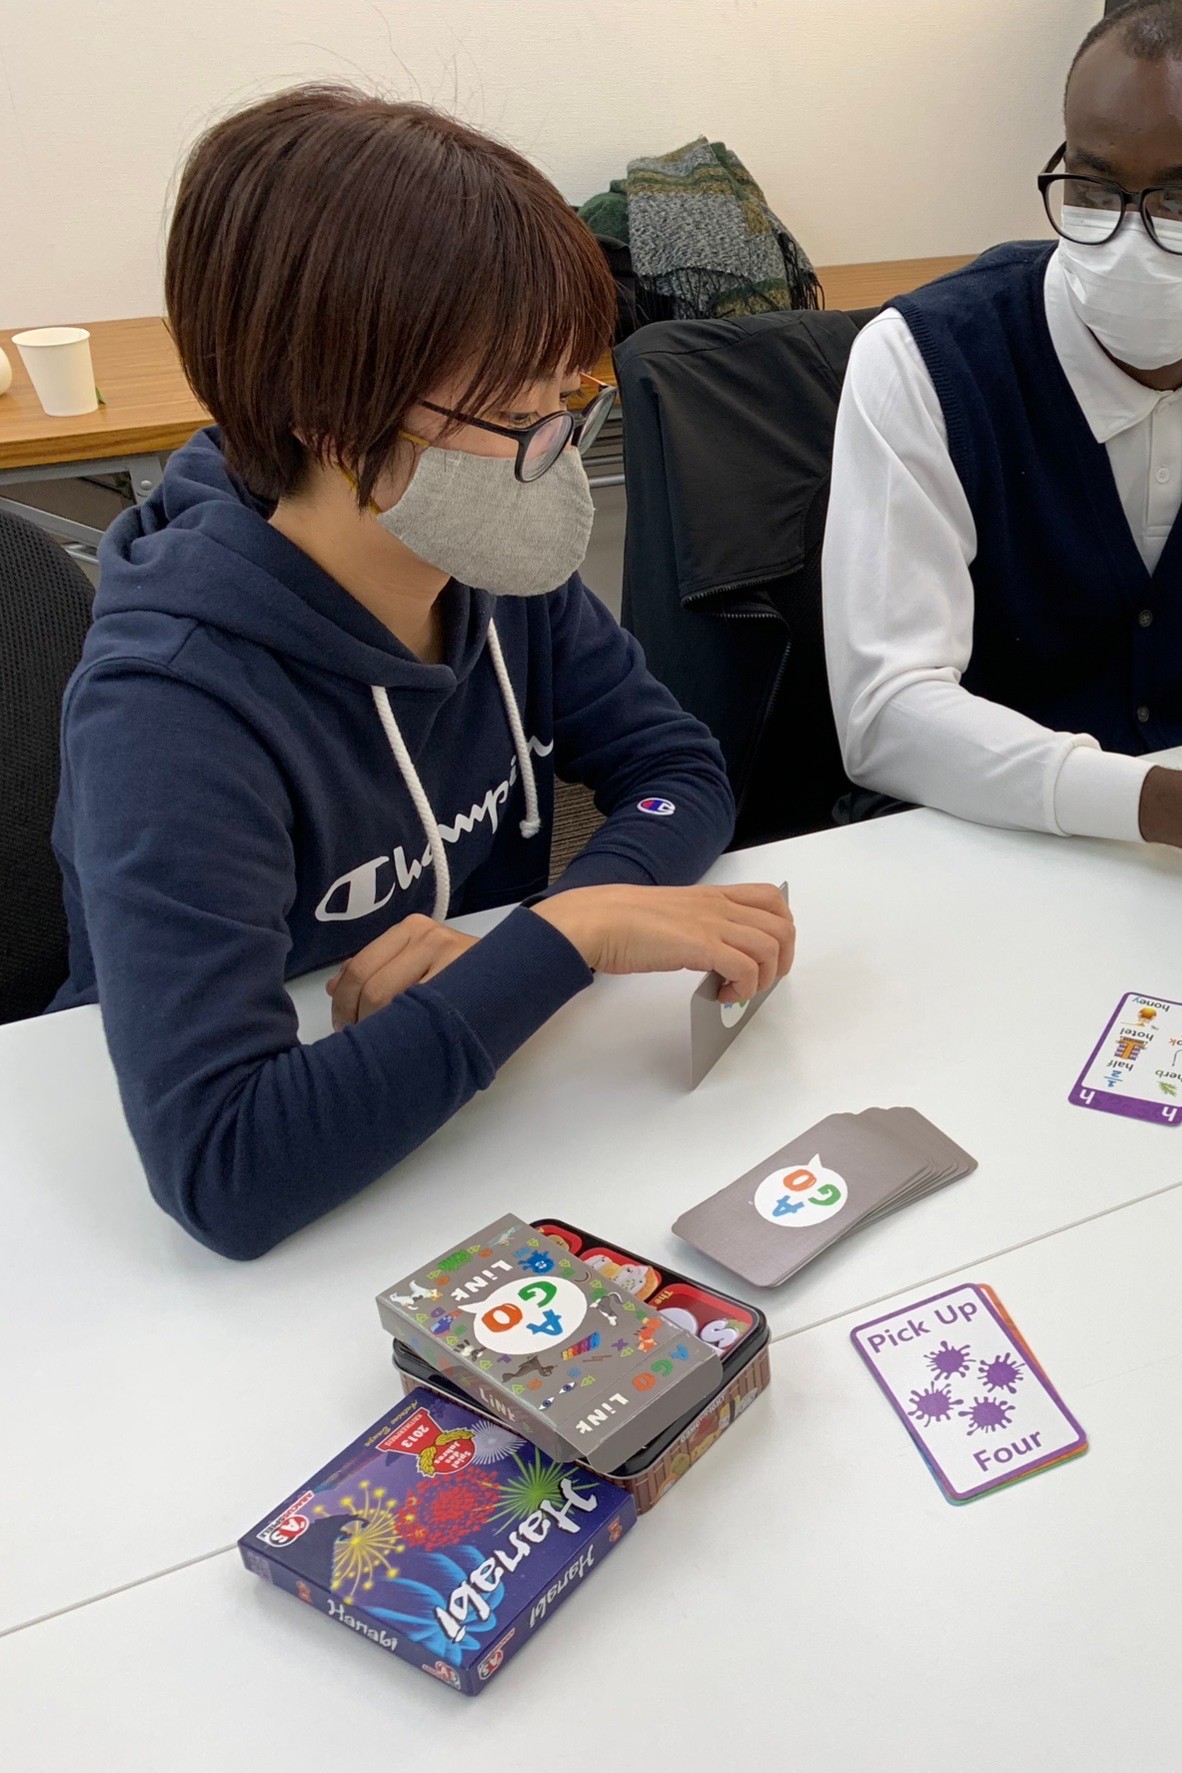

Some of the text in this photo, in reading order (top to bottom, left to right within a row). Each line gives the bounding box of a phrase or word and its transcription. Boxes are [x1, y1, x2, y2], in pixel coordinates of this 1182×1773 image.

[315, 735, 553, 921] Champin
[1132, 996, 1170, 1012] honey
[1120, 1027, 1154, 1041] hotel
[1106, 1060, 1134, 1071] half
[1080, 1090, 1096, 1104] h
[1162, 1106, 1178, 1122] h
[866, 1301, 978, 1354] Pick Up
[631, 1344, 689, 1392] AGO
[401, 1424, 429, 1448] 2013
[434, 1441, 461, 1465] Jahres
[444, 1451, 460, 1464] des
[451, 1450, 472, 1468] Spiel
[972, 1431, 1044, 1473] Four
[436, 1477, 598, 1642] Hanabi
[529, 1544, 595, 1628] Hanabi
[327, 1598, 398, 1651] Hanabi
